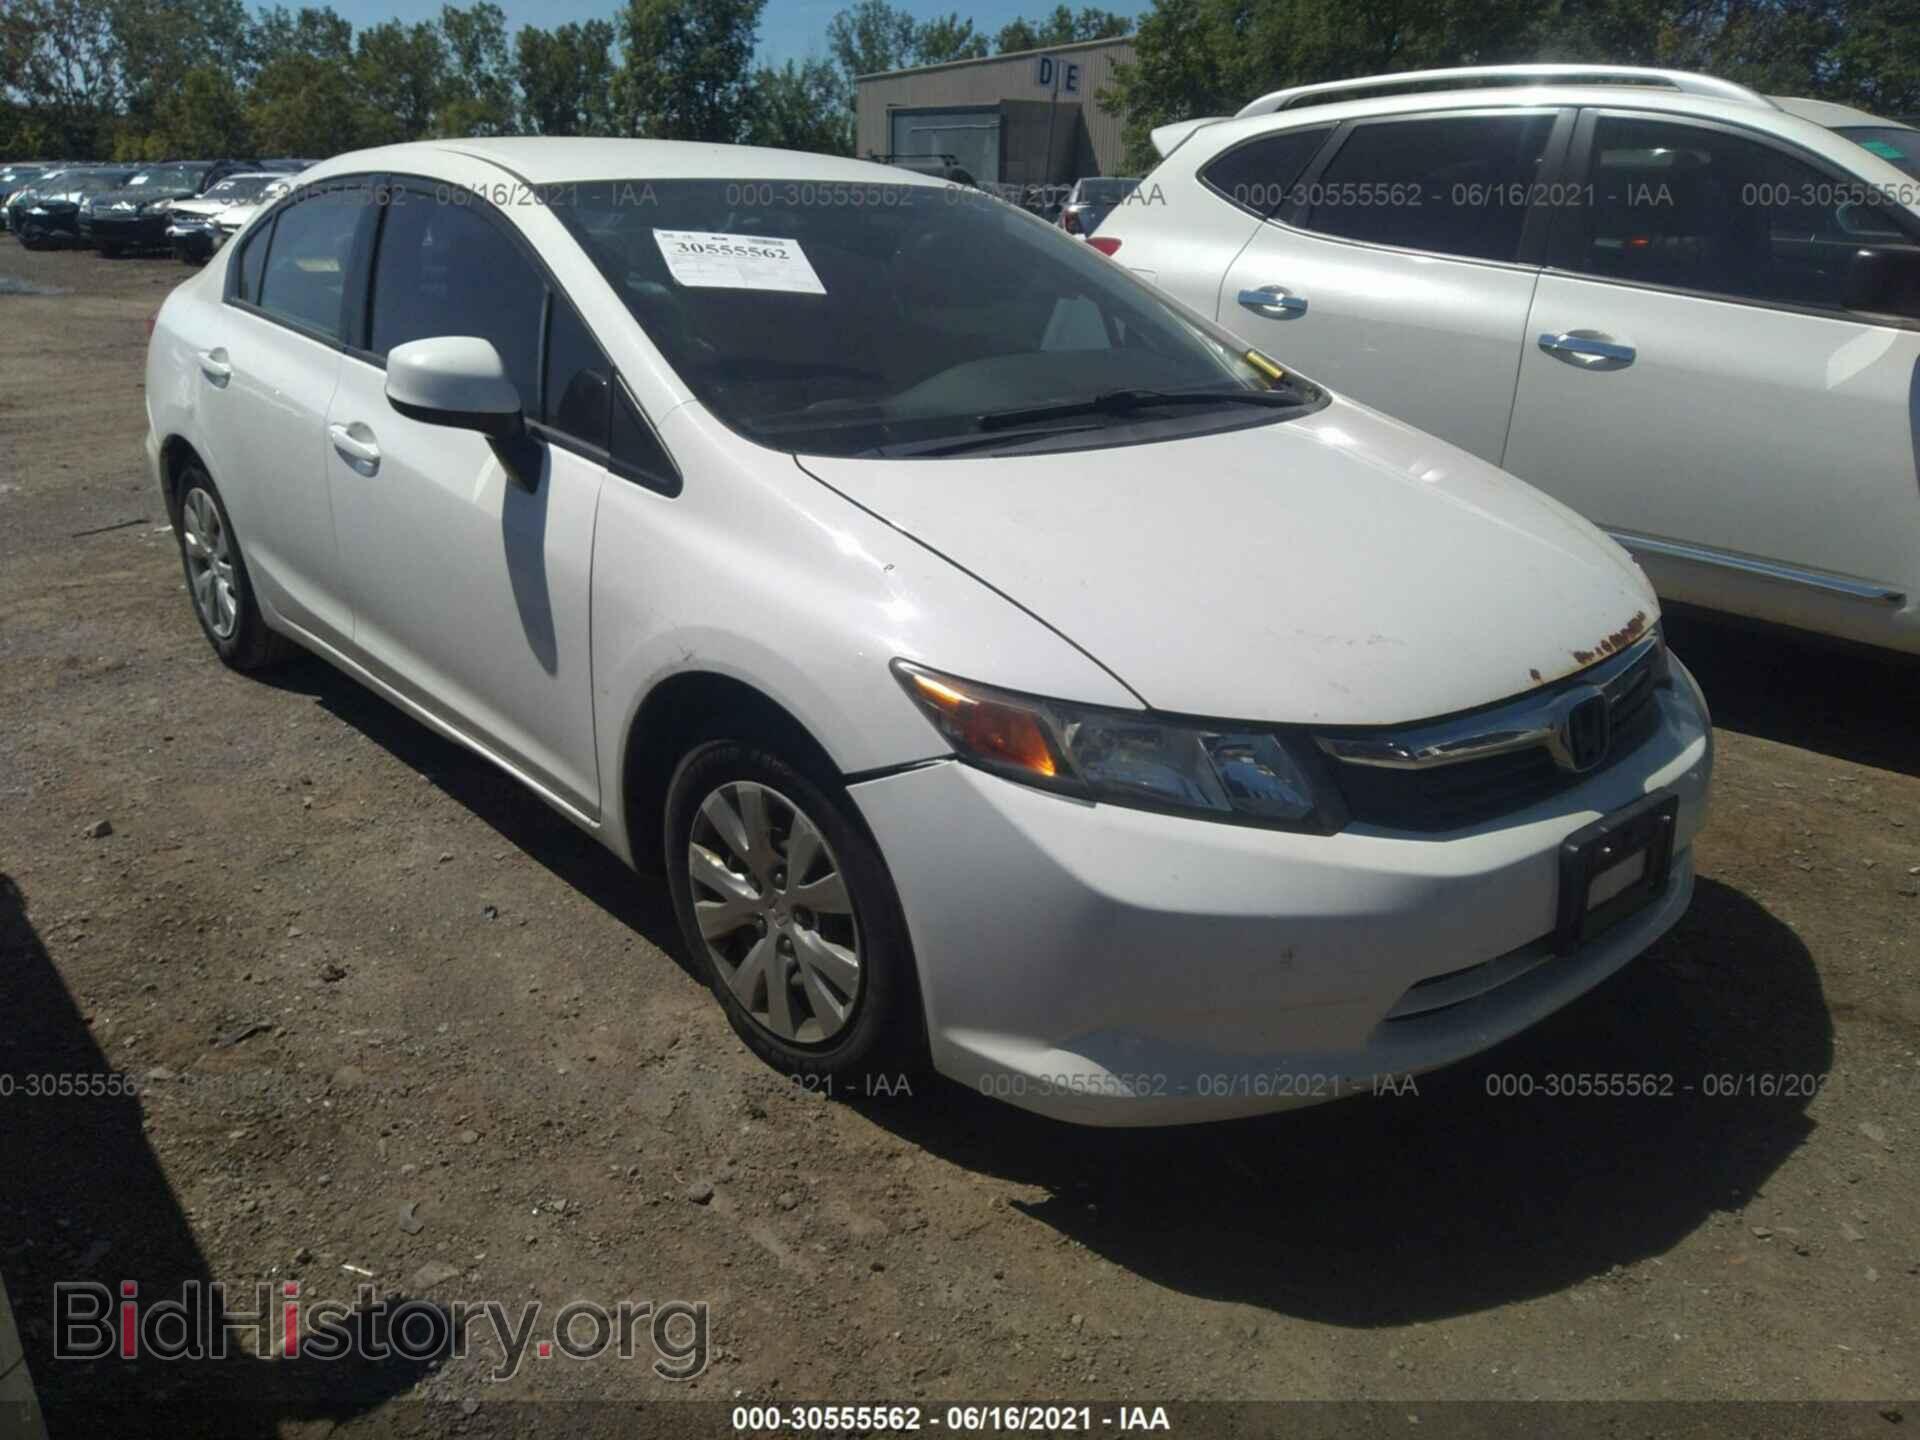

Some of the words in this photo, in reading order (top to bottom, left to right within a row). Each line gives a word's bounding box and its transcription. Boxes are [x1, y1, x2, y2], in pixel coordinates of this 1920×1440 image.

[1040, 57, 1053, 84] D
[1066, 64, 1078, 92] E
[675, 241, 791, 260] 30555562
